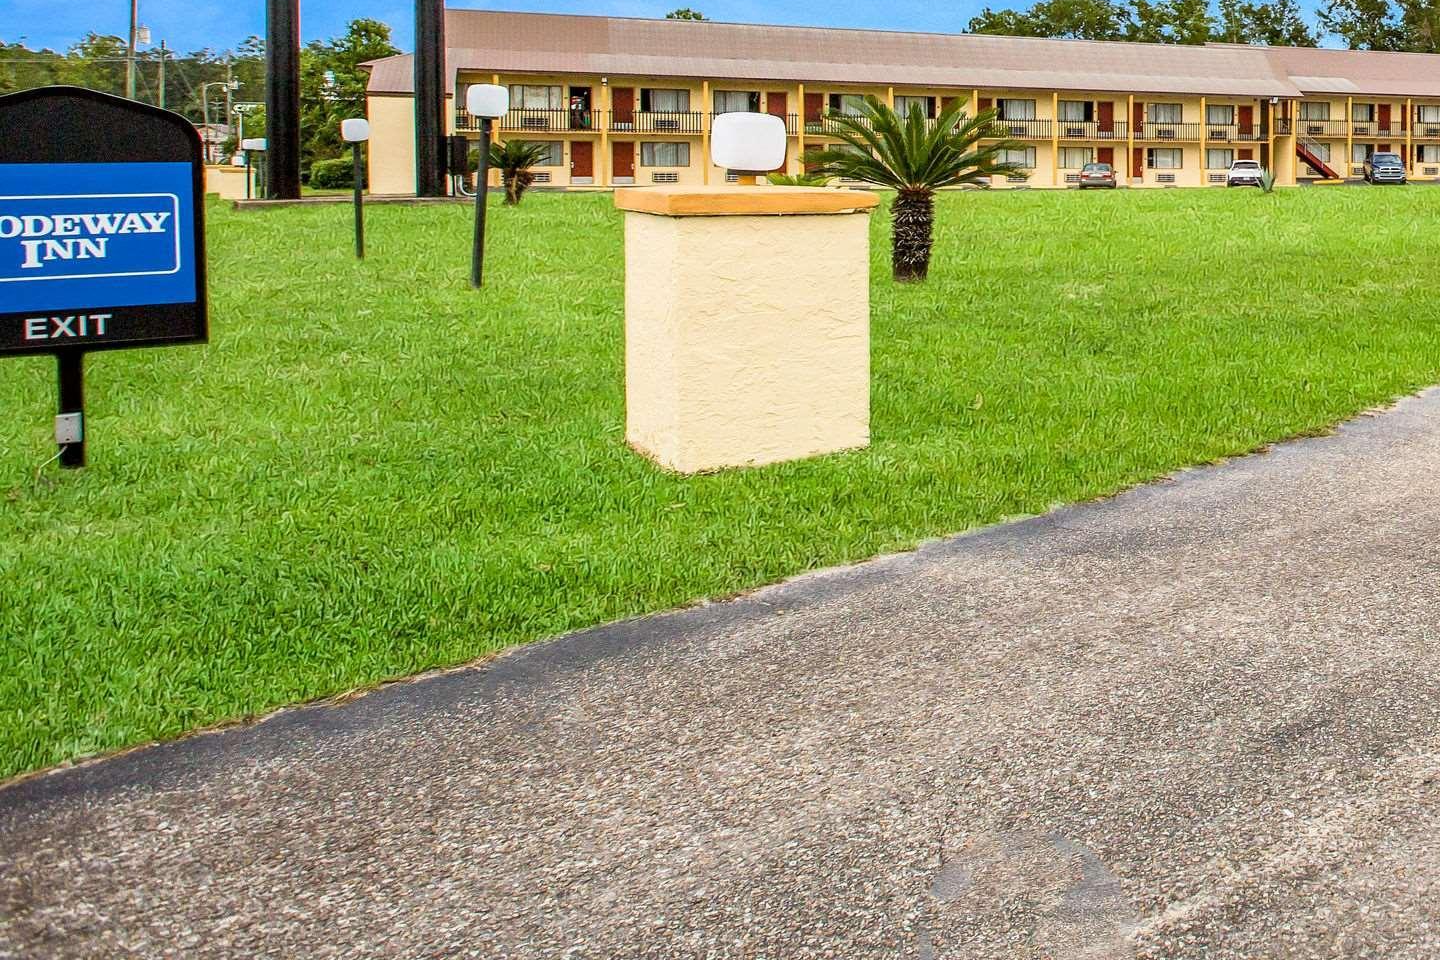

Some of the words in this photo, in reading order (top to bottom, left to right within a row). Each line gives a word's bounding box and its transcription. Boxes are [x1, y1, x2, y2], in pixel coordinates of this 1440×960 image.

[0, 212, 171, 238] ODEWAY
[20, 238, 109, 268] INN
[24, 313, 113, 340] EXIT
